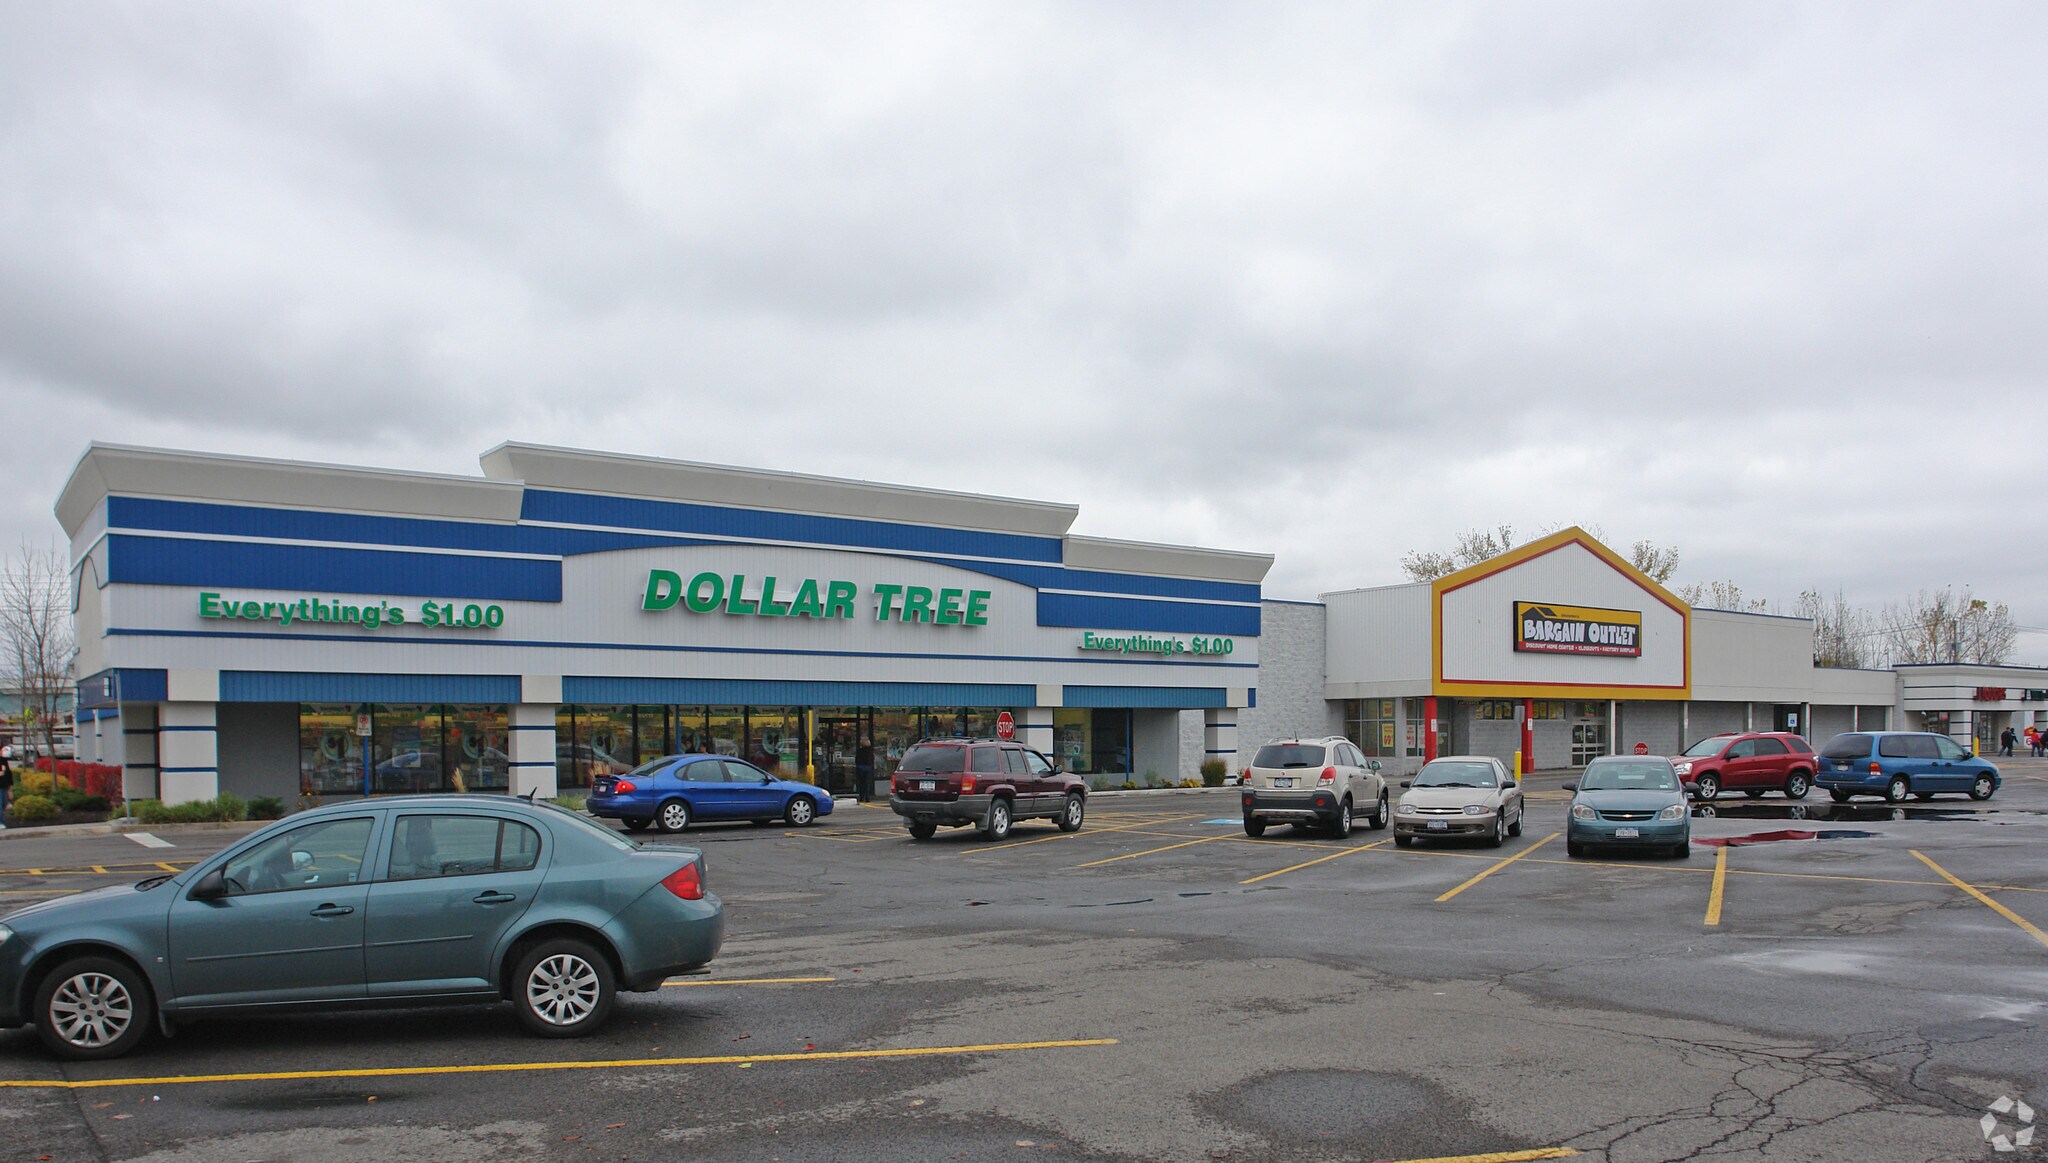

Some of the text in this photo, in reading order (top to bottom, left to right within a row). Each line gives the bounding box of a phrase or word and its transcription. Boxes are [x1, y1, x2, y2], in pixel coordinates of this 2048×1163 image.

[199, 591, 505, 629] Everything's $1.00
[641, 569, 992, 626] DOLLAR TREE
[1083, 631, 1234, 656] Everything's $1.00
[1524, 619, 1636, 645] BARGAIN OUTLET
[1525, 642, 1546, 650] DISCOUNT
[998, 721, 1013, 733] STOP
